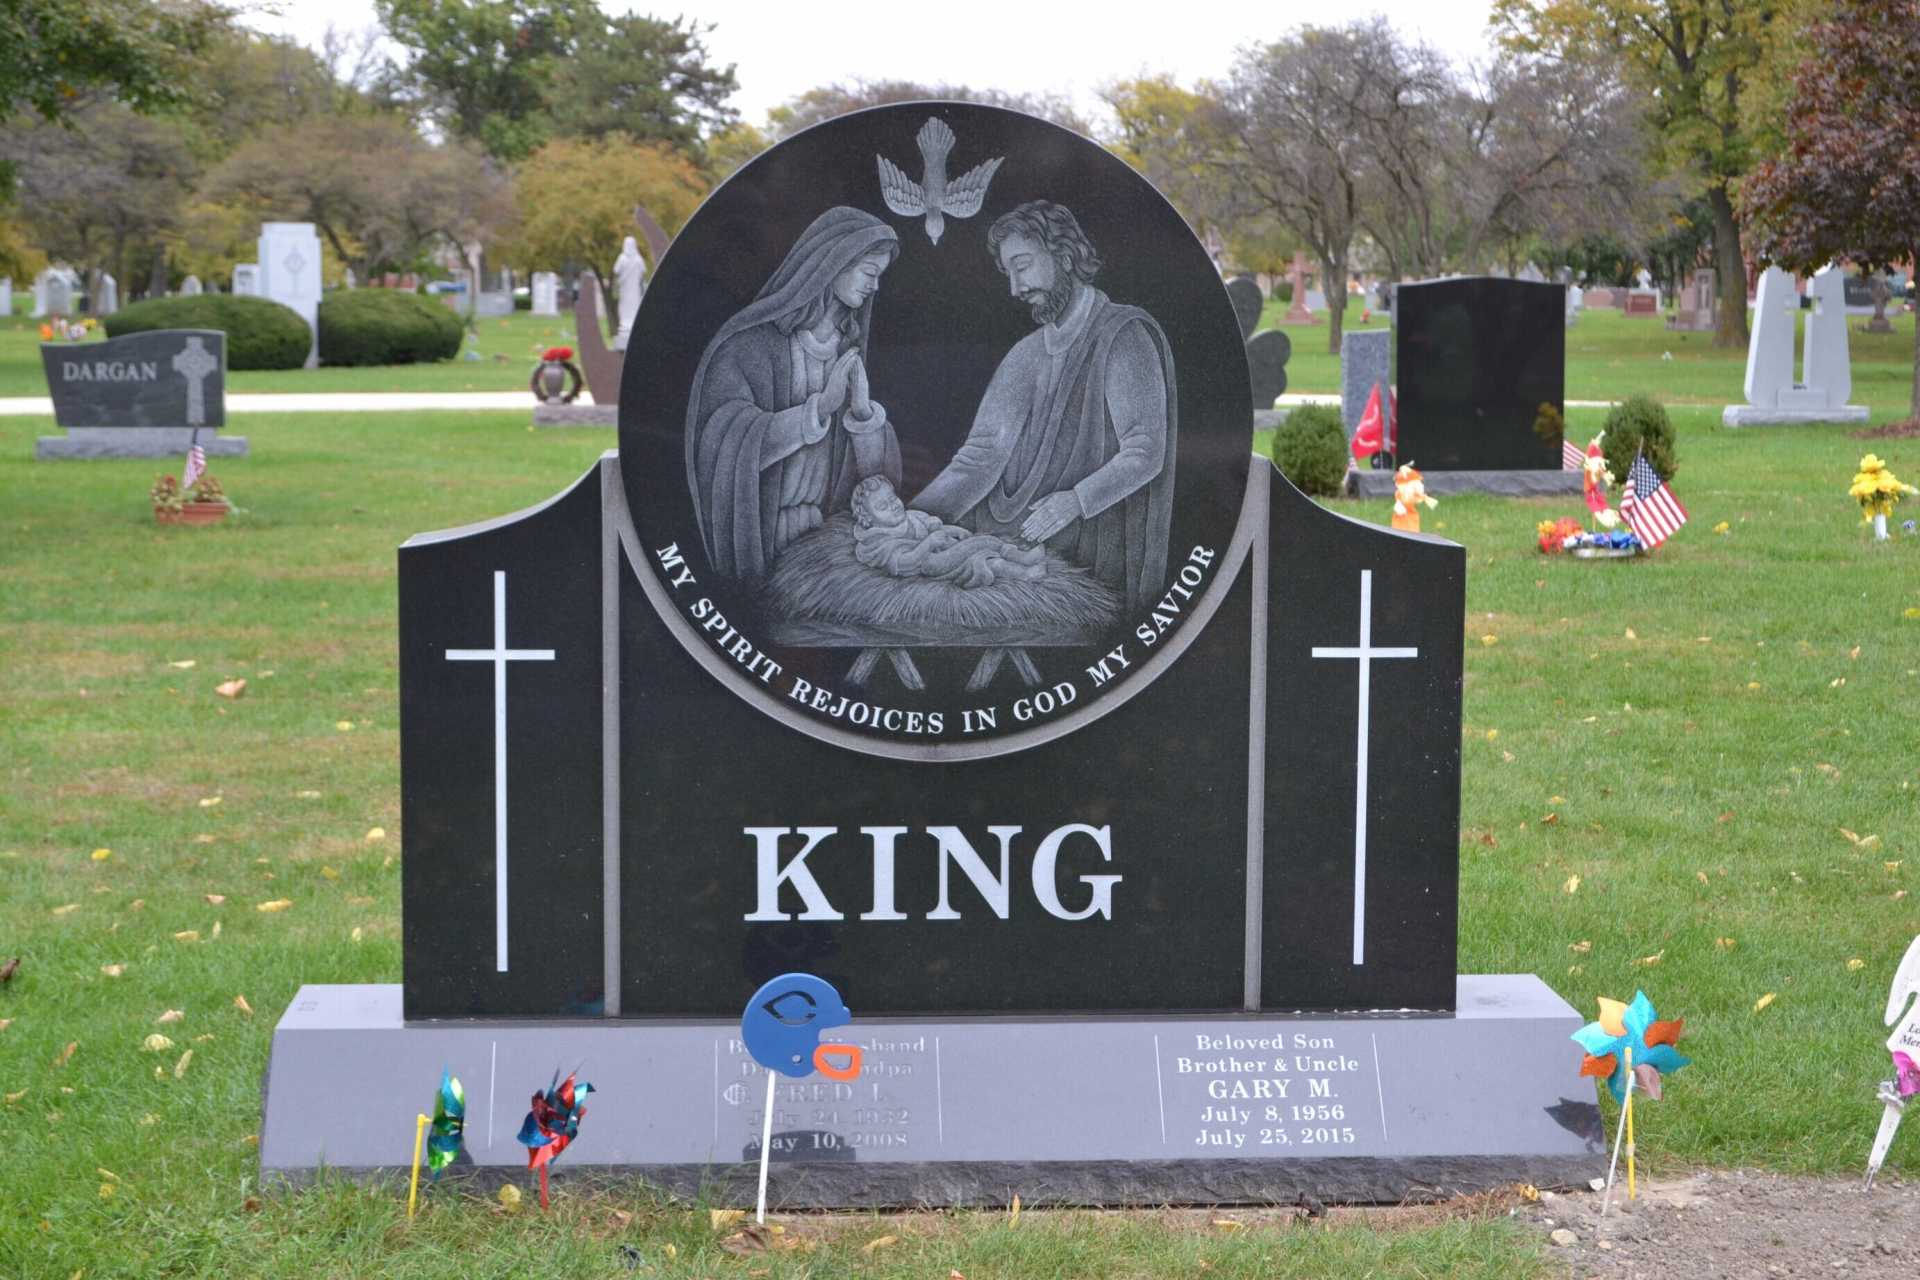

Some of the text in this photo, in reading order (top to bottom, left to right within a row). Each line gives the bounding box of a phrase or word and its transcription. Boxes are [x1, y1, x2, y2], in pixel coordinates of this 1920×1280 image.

[62, 361, 158, 382] DARGAN
[656, 541, 1216, 735] MY SPIRIT REJOICES IN GOD MY SAVIOR
[743, 823, 1123, 921] KING
[1195, 1033, 1336, 1051] Beloved Son
[1177, 1055, 1360, 1073] Brother & Uncle
[1208, 1078, 1339, 1099] GARY M.
[1201, 1104, 1346, 1126] July 8, 1956
[812, 1133, 841, 1152] 10,
[852, 1133, 909, 1149] 2008
[1195, 1127, 1356, 1149] July 25, 2015
